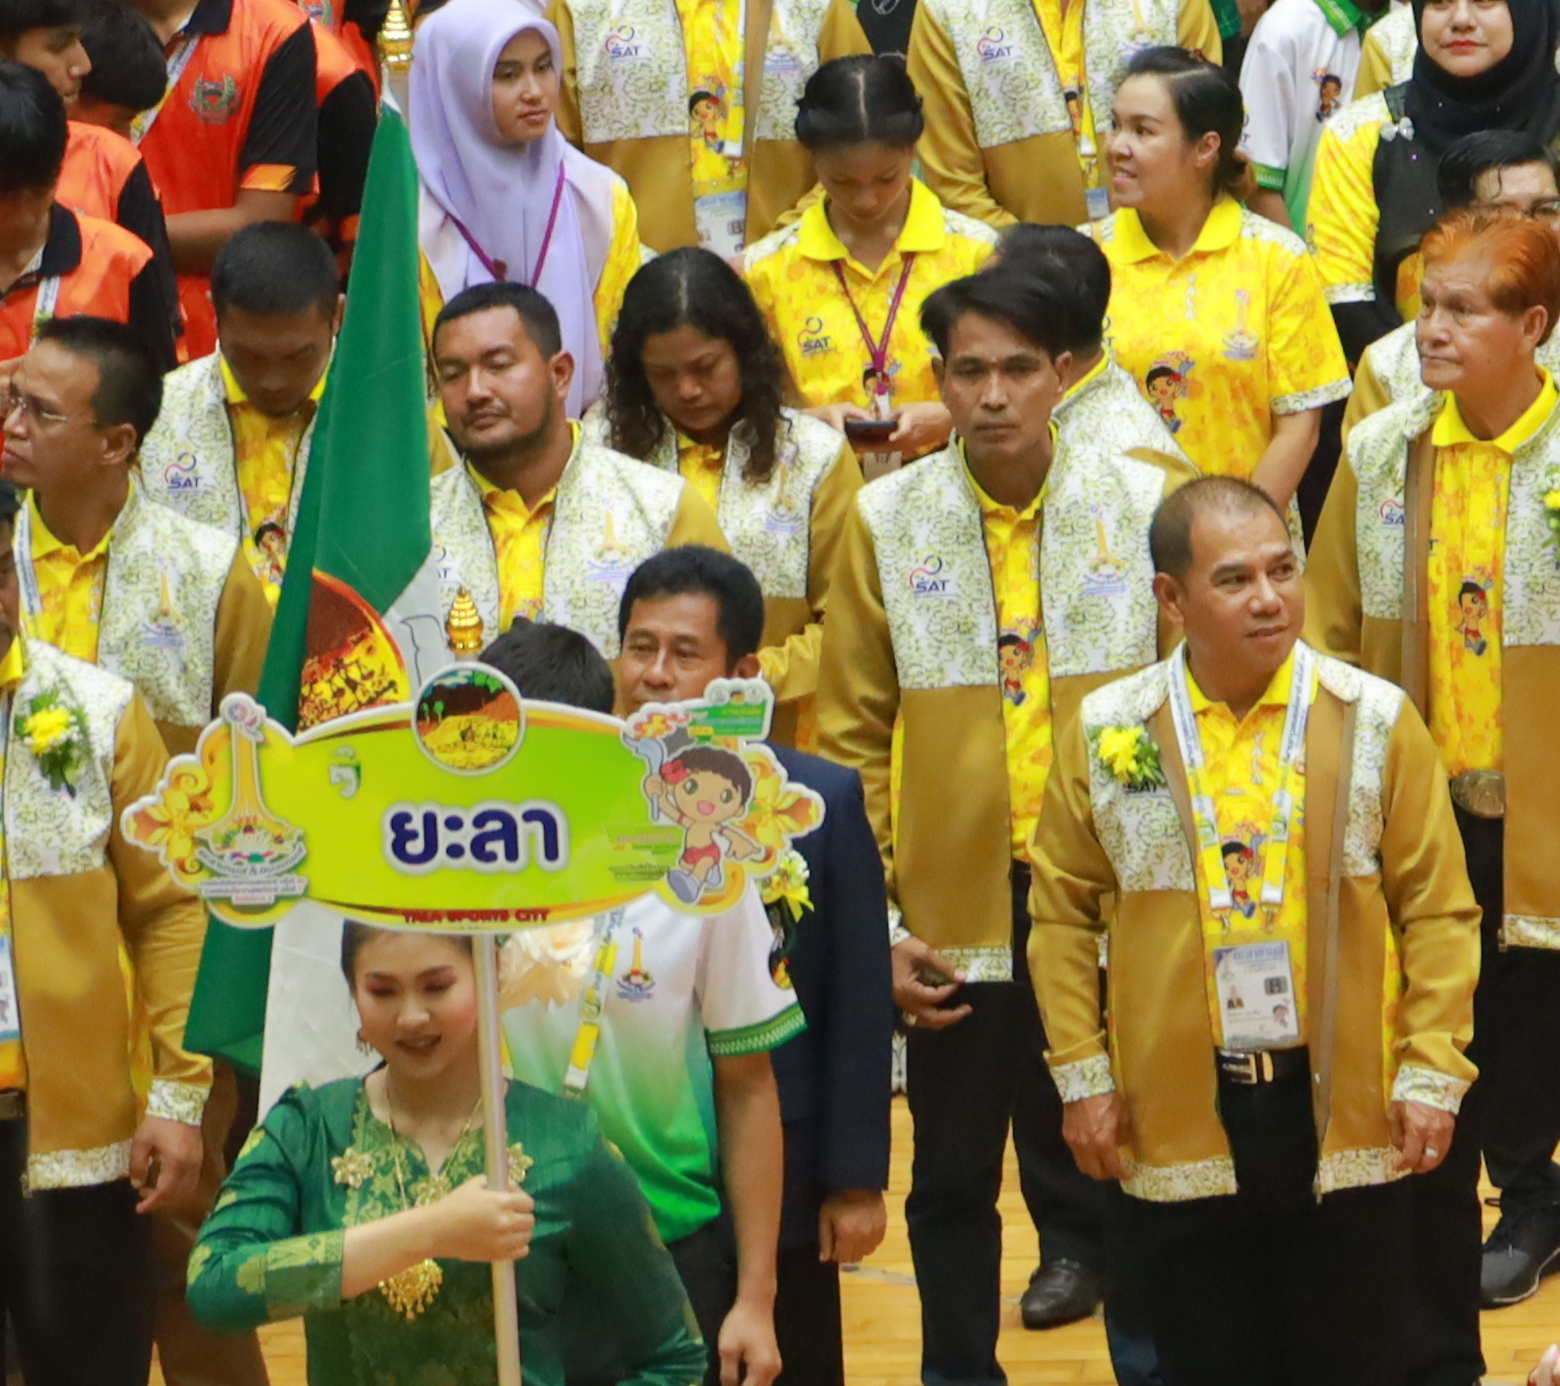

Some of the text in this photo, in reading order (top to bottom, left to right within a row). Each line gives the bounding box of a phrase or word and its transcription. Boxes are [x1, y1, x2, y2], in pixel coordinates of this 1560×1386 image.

[611, 44, 641, 58] SAT
[983, 45, 1013, 58] SAT
[802, 336, 831, 349] SAT
[170, 477, 201, 489] SAT
[1385, 513, 1405, 525] SA
[916, 581, 949, 594] SAT
[388, 807, 560, 866] ยะลา
